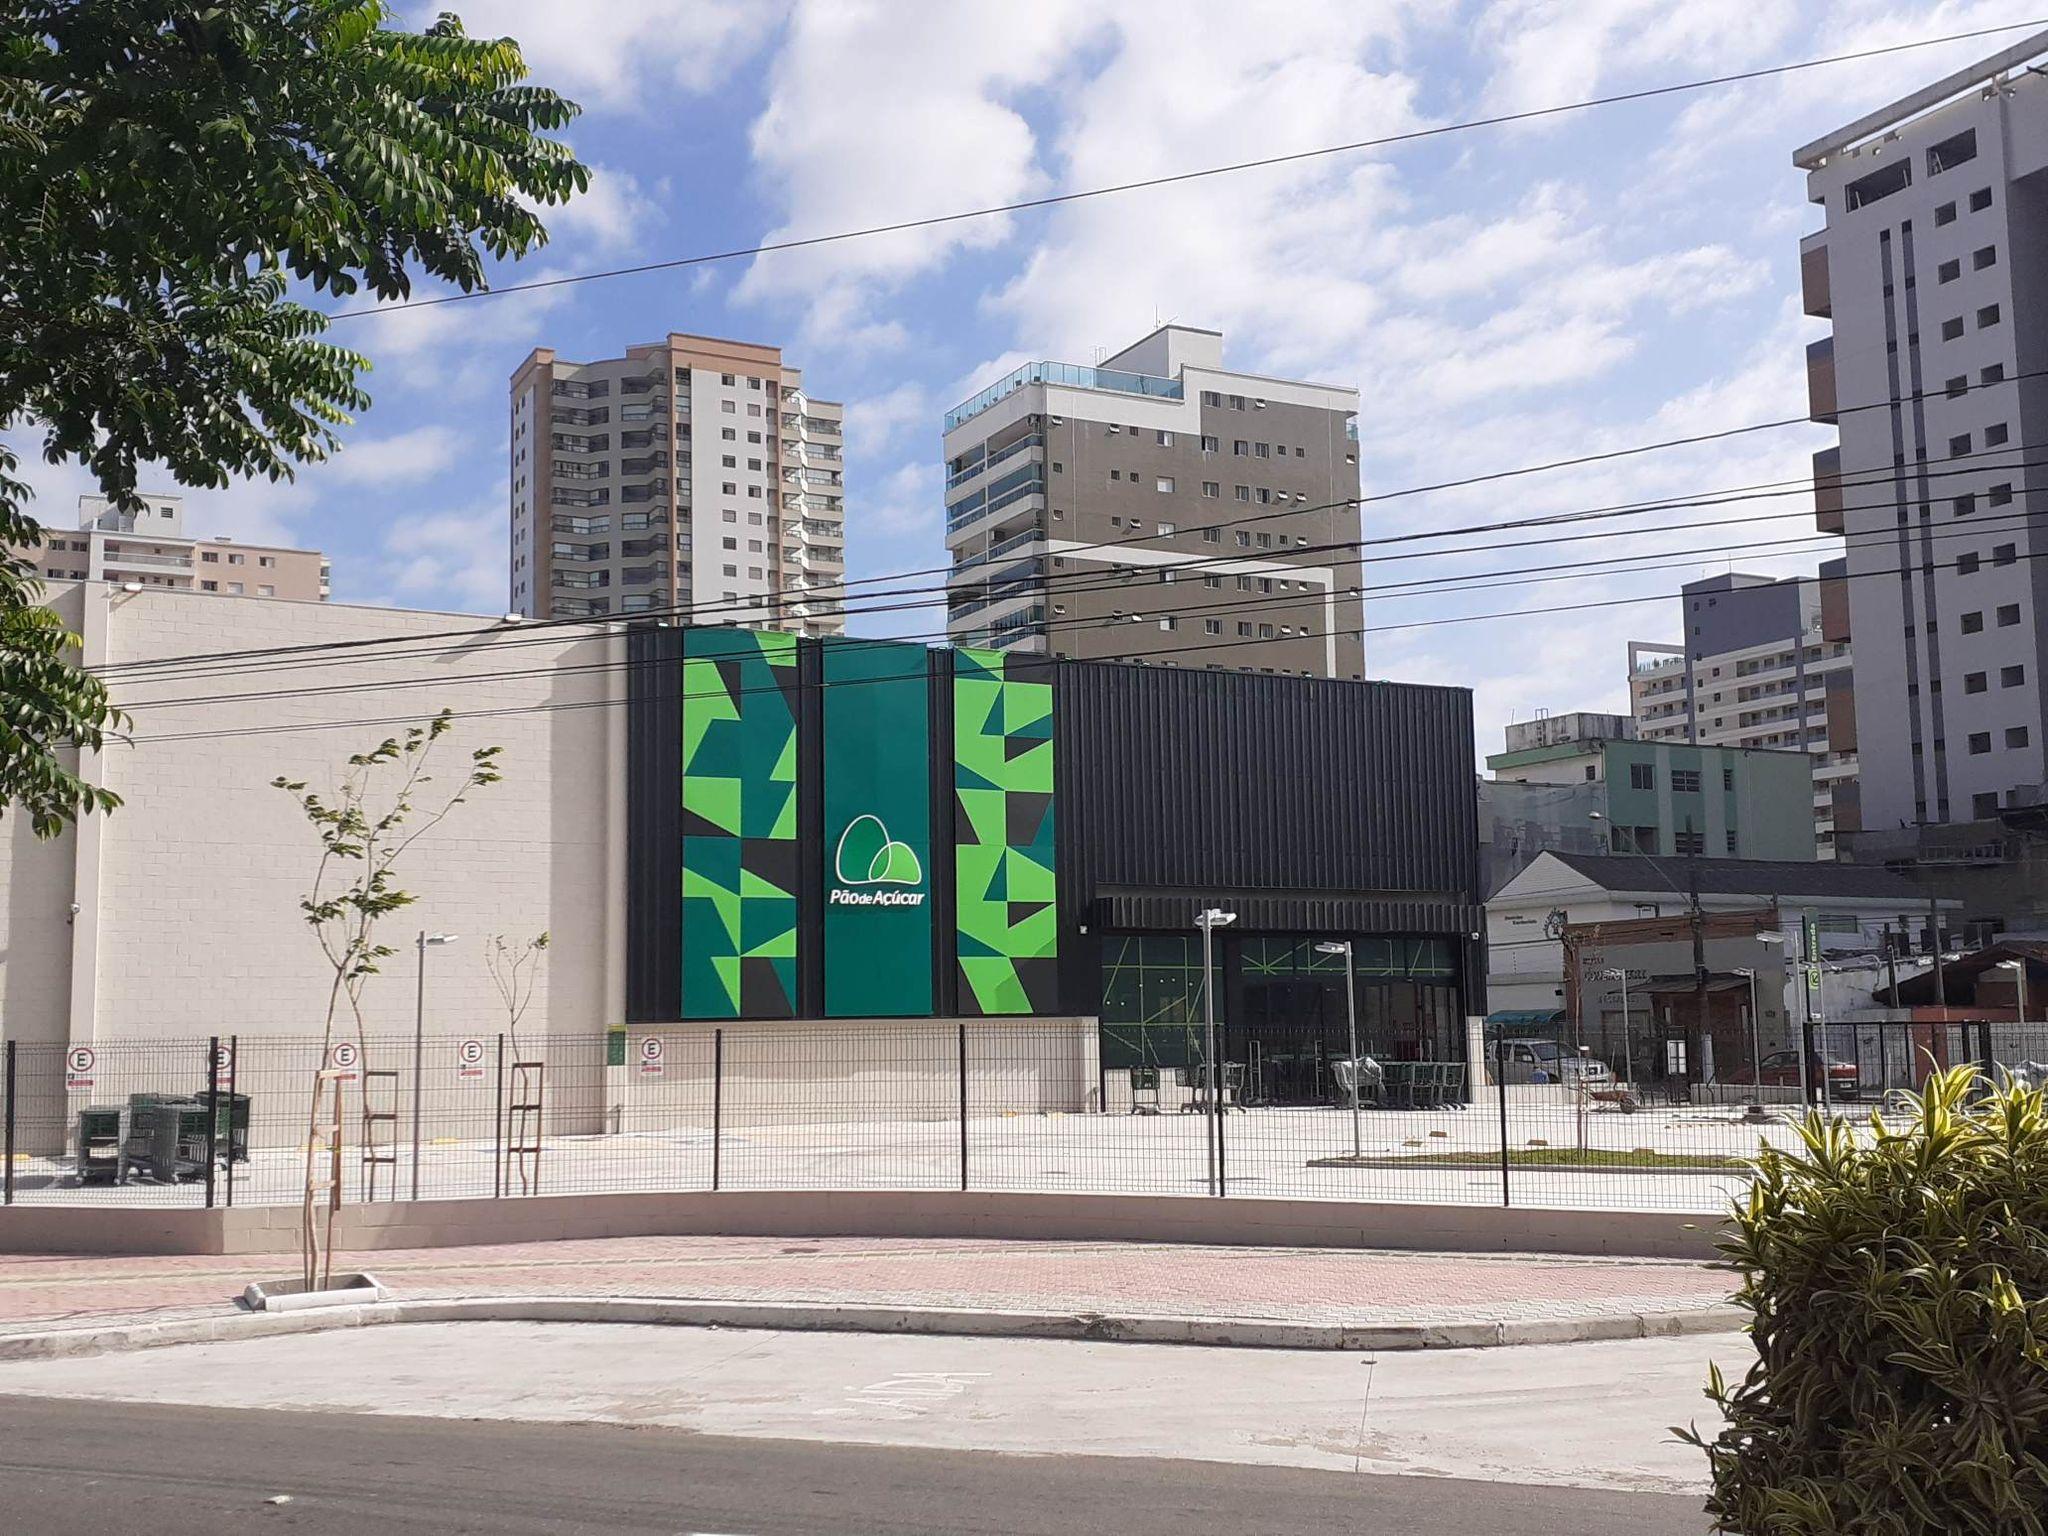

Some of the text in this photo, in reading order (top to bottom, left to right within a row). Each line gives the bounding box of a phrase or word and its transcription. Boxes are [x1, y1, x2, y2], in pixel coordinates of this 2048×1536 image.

[830, 889, 925, 906] Pão de Açúcar
[1809, 922, 1817, 962] Entrada
[468, 1045, 477, 1058] E
[647, 1042, 656, 1055] E
[77, 1053, 87, 1067] E
[341, 1049, 350, 1062] E
